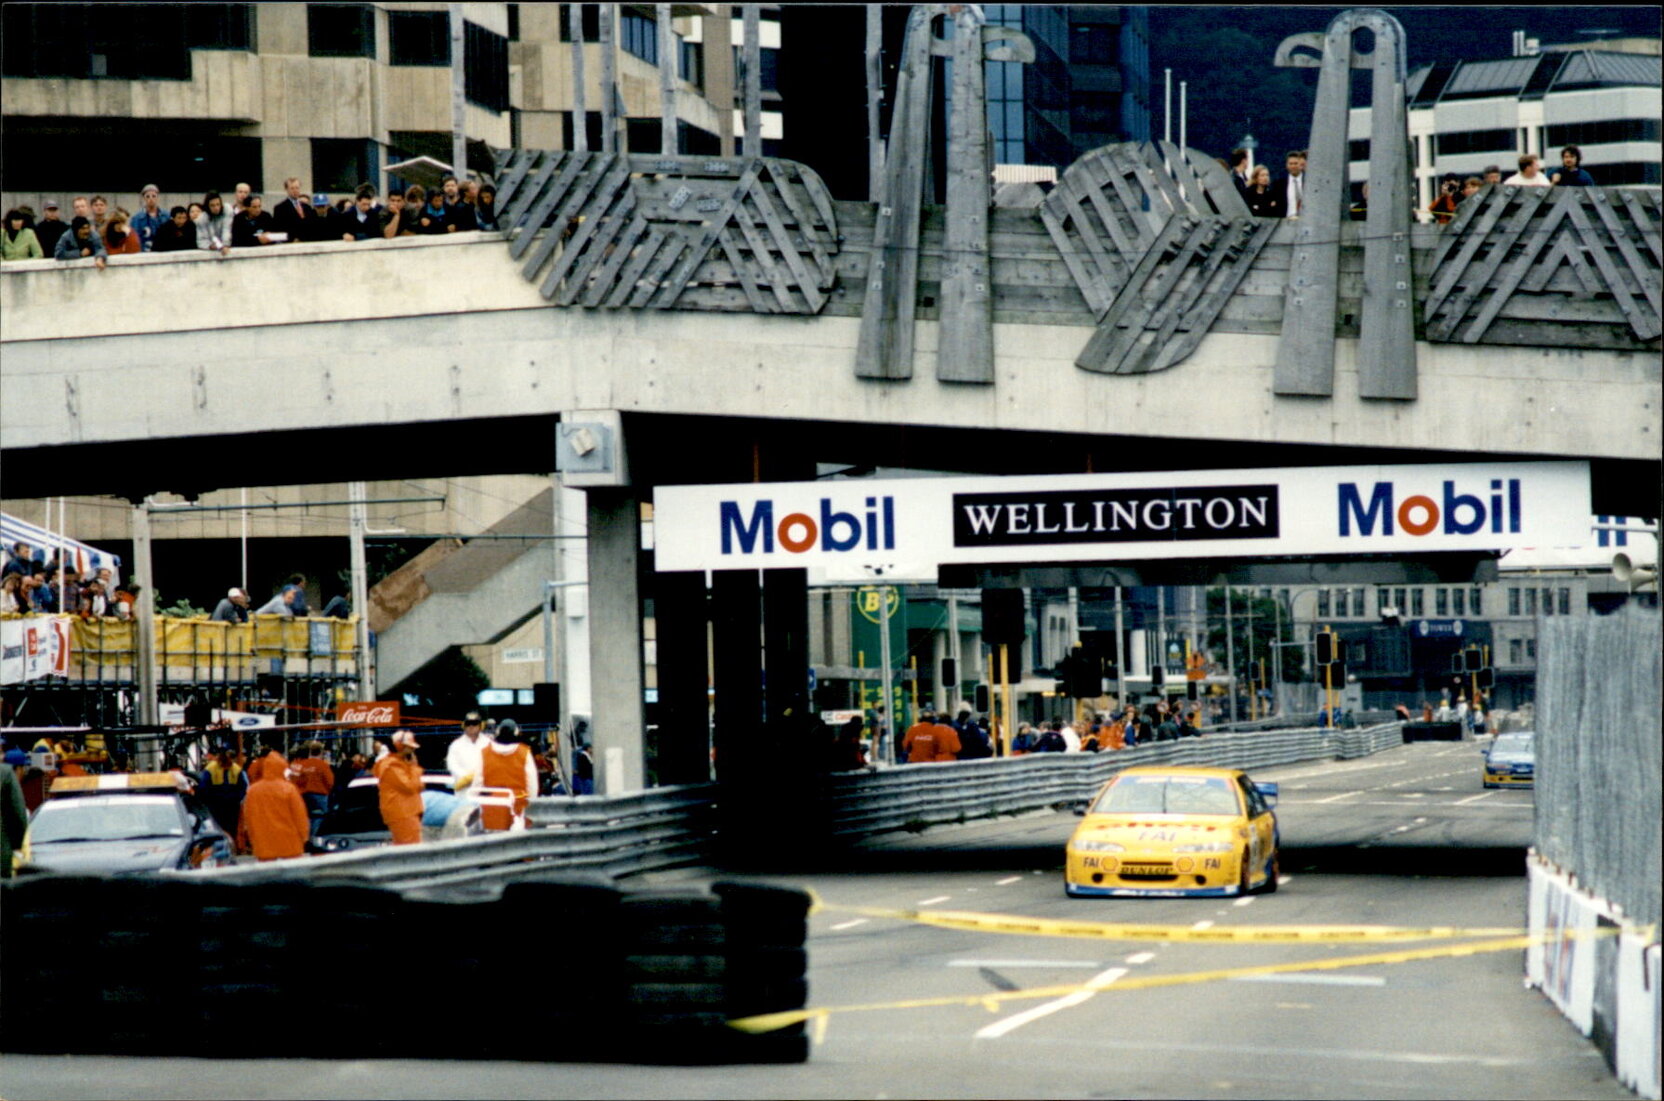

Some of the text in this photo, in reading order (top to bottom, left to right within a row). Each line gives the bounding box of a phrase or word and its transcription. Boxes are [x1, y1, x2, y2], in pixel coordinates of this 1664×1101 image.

[1337, 478, 1523, 536] Mobil
[962, 493, 1270, 536] WELLINGTON
[719, 493, 896, 555] Mobil
[1138, 831, 1177, 841] FAI
[1083, 857, 1099, 867] FAI
[1204, 858, 1221, 869] FAI
[1120, 867, 1173, 875] DUNLOP
